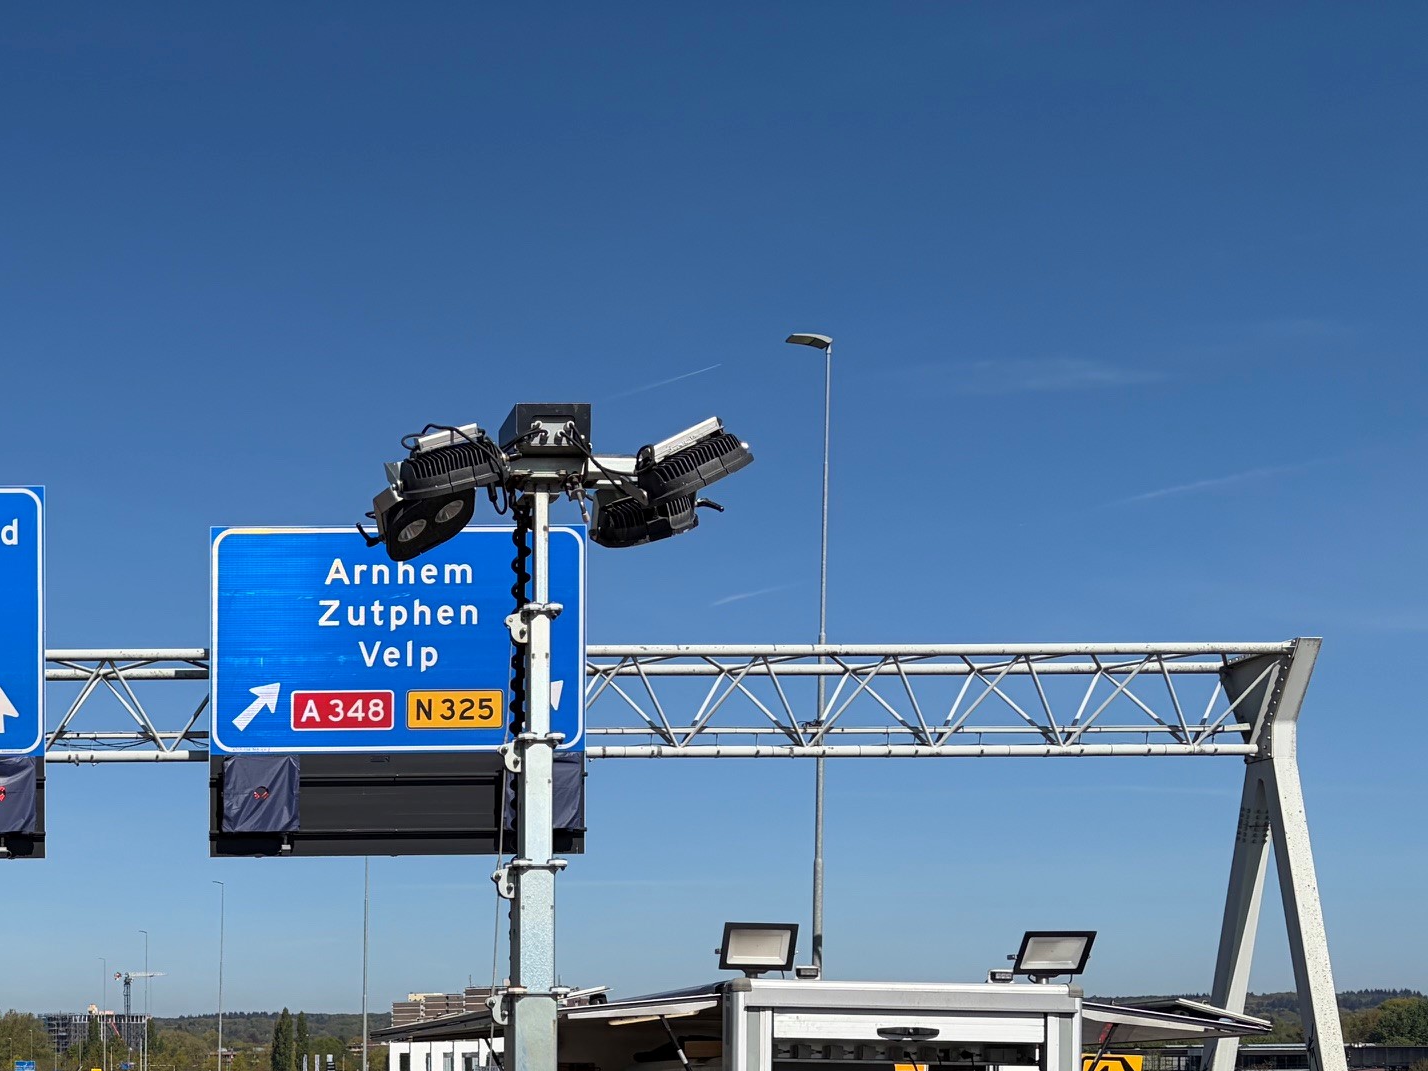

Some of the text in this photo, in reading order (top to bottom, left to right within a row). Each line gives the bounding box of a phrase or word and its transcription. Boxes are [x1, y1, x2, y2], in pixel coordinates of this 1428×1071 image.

[324, 557, 473, 586] Arnhem
[318, 598, 479, 632] Zutphen
[358, 639, 439, 673] Velp
